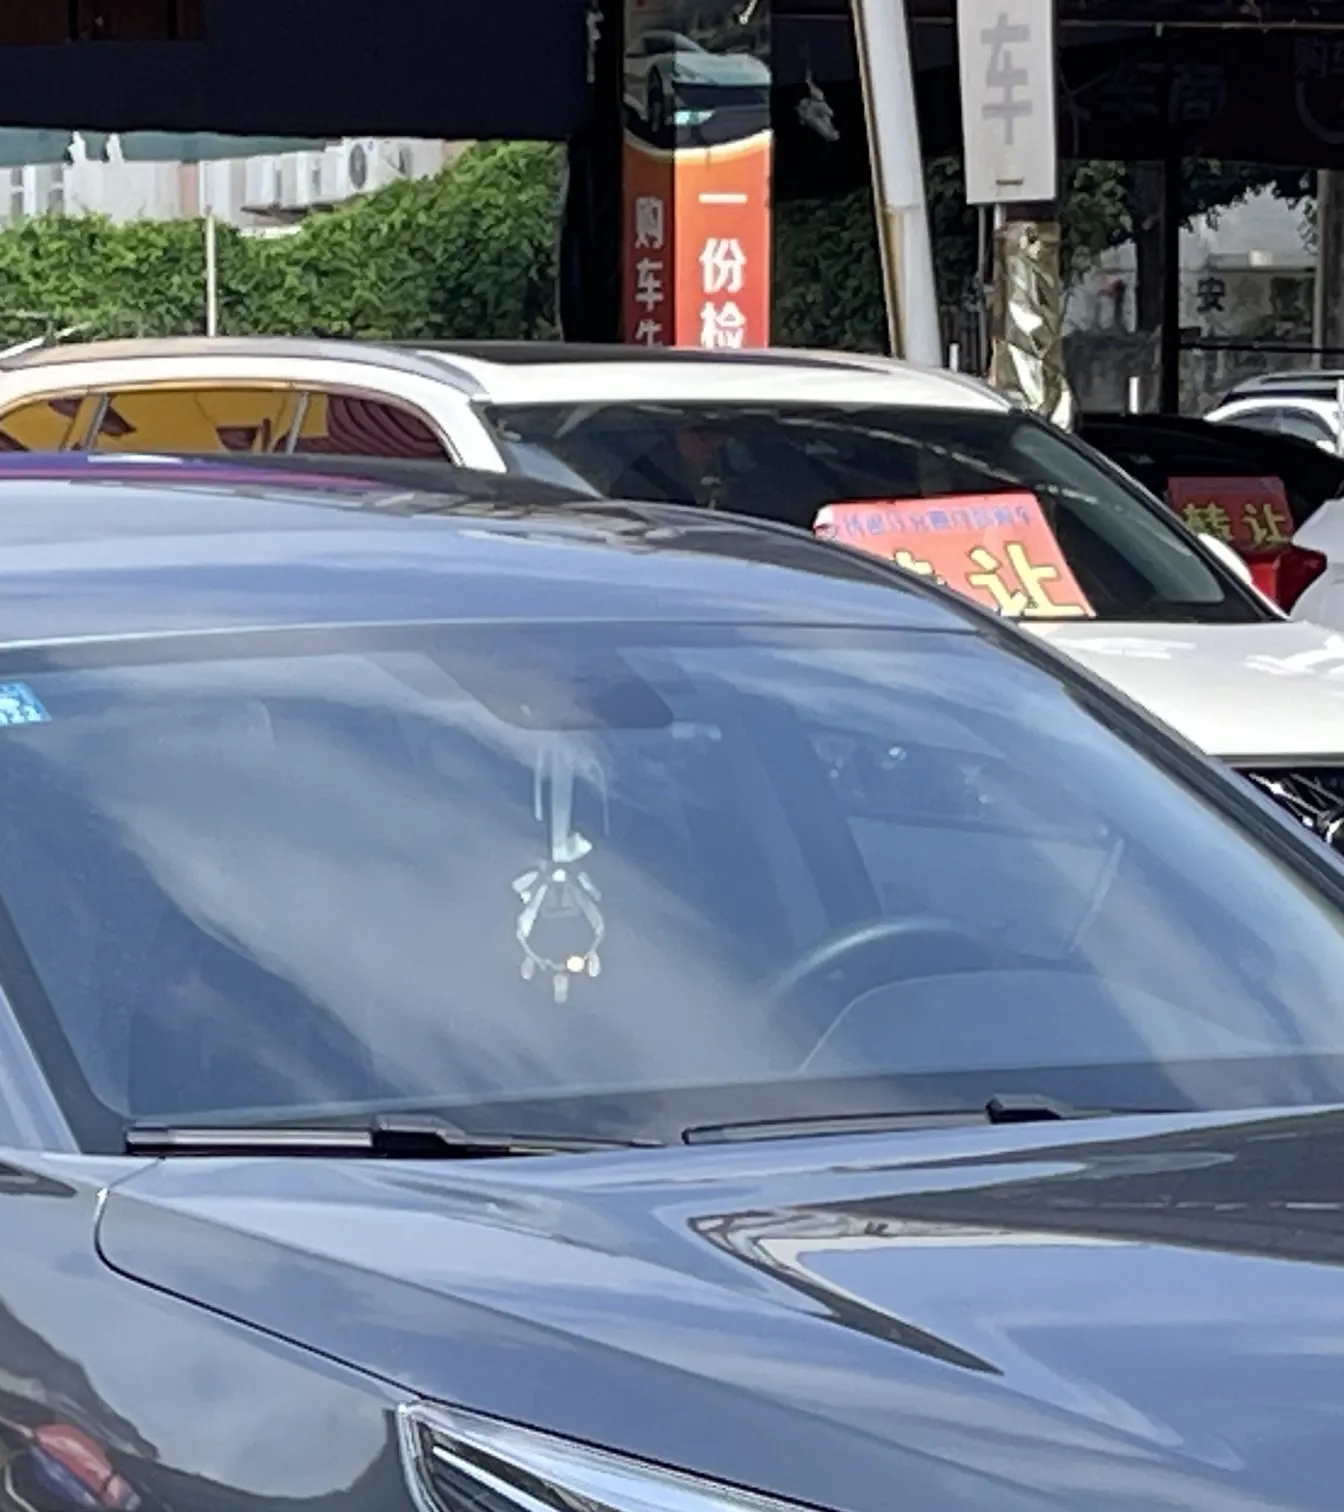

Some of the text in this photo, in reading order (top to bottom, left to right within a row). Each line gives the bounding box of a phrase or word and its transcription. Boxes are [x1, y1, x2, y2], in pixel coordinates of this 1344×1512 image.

[980, 12, 1033, 146] 车
[698, 192, 748, 348] 一份检
